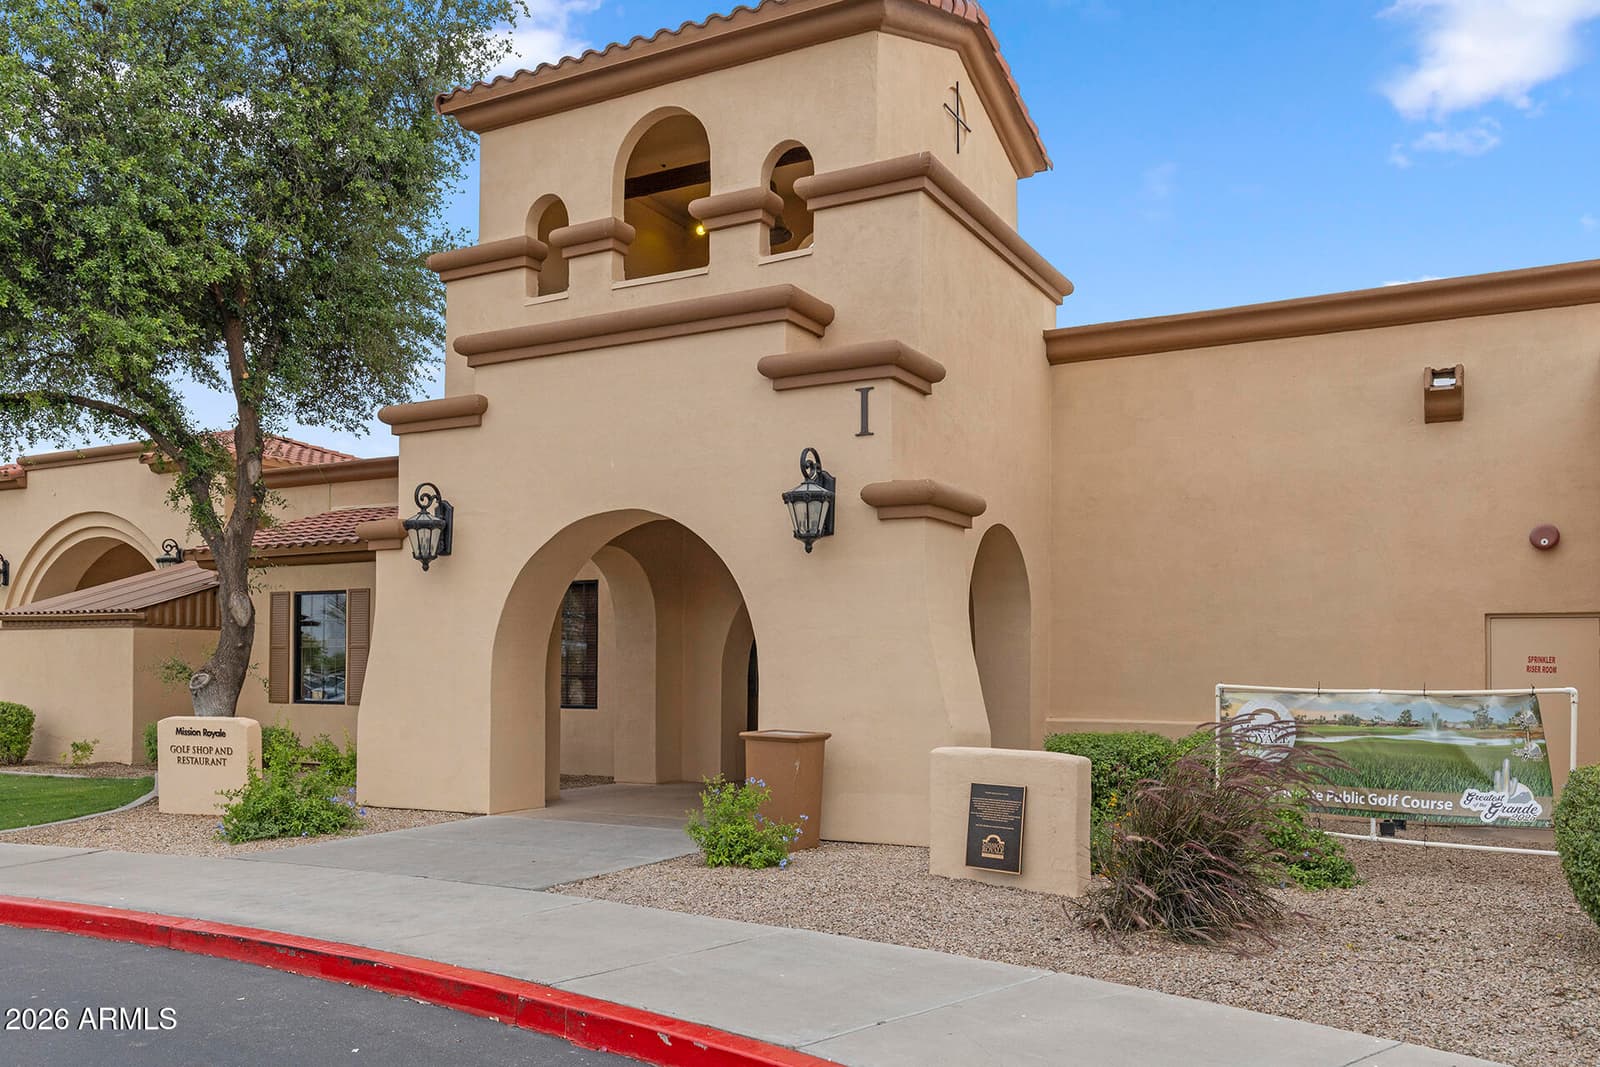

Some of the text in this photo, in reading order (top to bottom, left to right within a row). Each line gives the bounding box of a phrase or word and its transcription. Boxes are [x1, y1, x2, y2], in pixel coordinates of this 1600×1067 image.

[1527, 655, 1556, 664] SPRINKLER
[1526, 665, 1557, 674] RISER ROOM
[175, 727, 226, 738] Mission Royale
[169, 745, 233, 756] GOLF SHOP AND
[177, 756, 227, 766] RESTAURANT
[1326, 790, 1366, 804] Public
[1368, 793, 1399, 807] Golf
[1401, 795, 1453, 811] Course
[1464, 792, 1505, 805] Greatest
[1484, 802, 1538, 819] Grande
